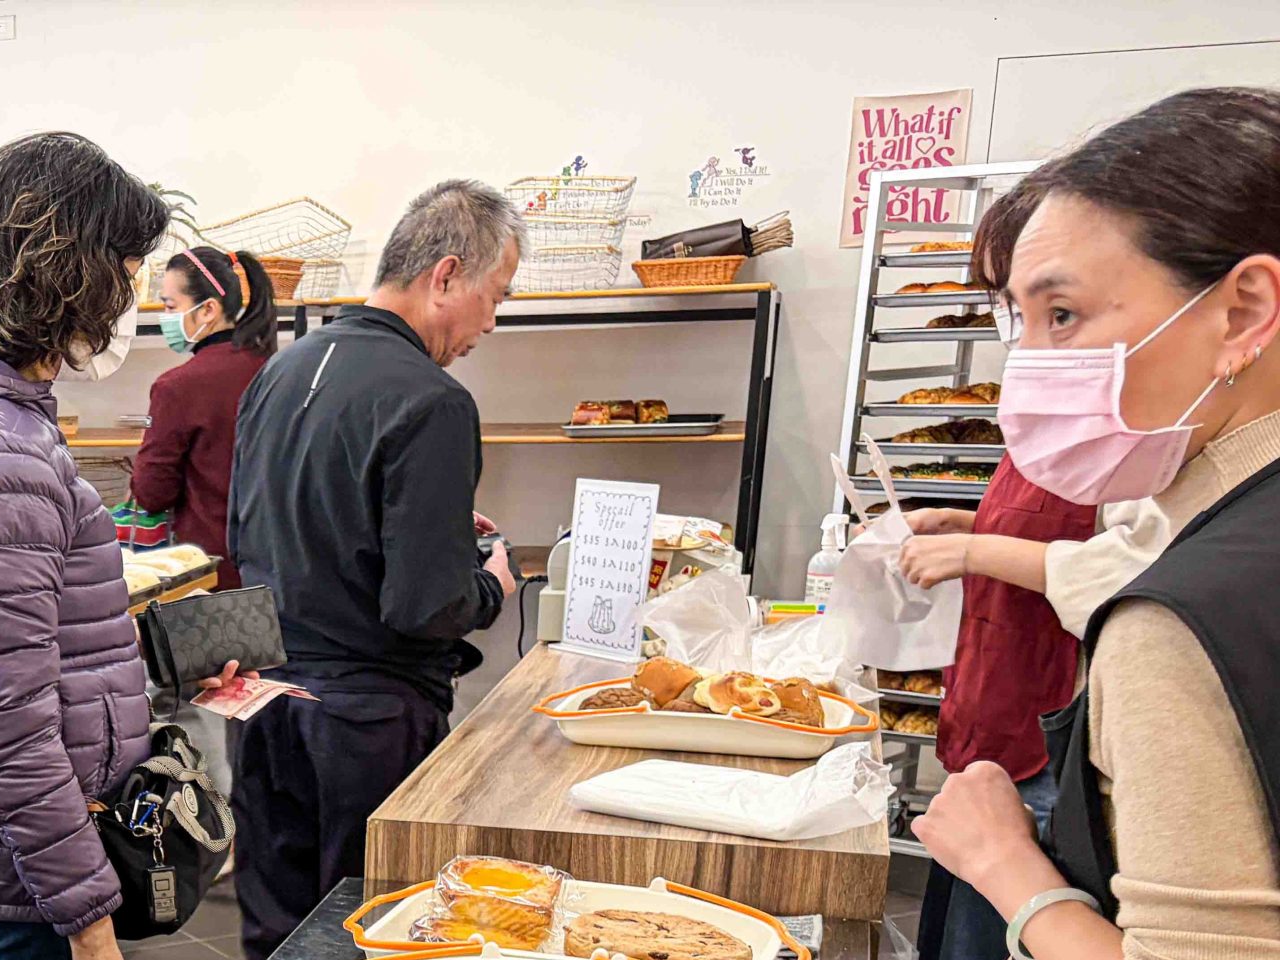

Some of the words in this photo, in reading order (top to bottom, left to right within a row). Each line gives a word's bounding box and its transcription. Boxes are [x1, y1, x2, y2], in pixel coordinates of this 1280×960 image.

[861, 105, 935, 139] What
[937, 107, 962, 140] if
[857, 139, 878, 165] it
[881, 134, 913, 163] all
[852, 187, 950, 234] rght
[598, 514, 626, 531] offer
